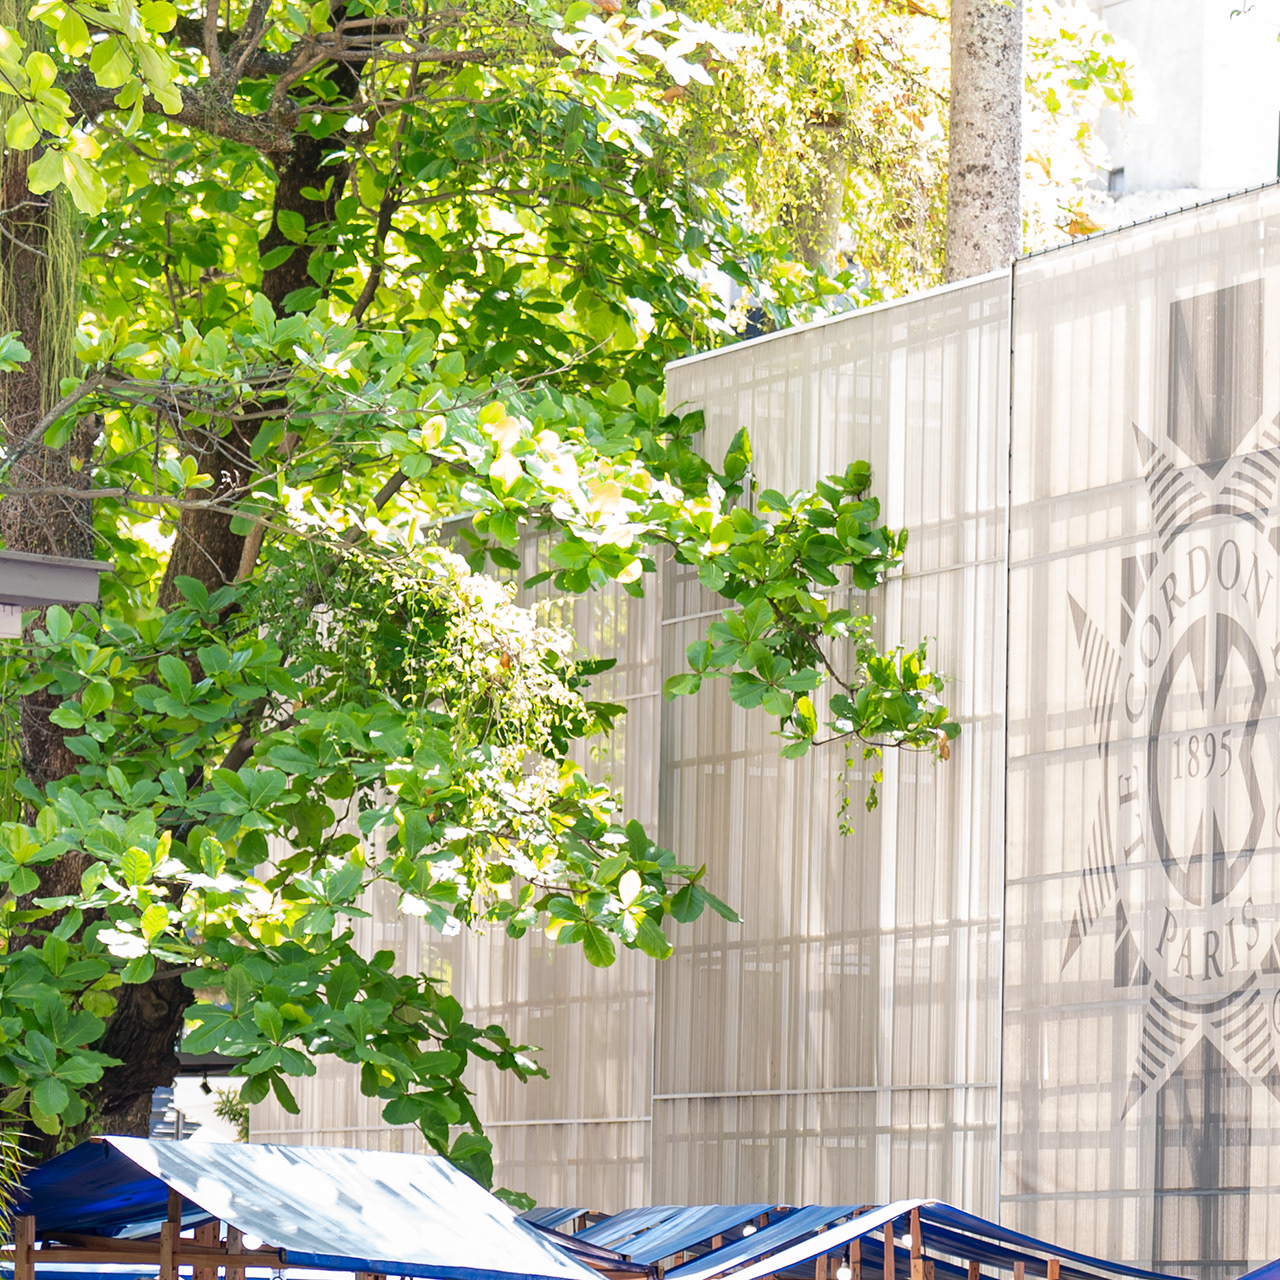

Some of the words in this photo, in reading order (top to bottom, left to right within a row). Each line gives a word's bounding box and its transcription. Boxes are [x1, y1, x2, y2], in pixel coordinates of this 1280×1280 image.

[1125, 539, 1273, 724] CORDON
[1173, 729, 1233, 780] 1895
[1155, 897, 1260, 981] PARIS
